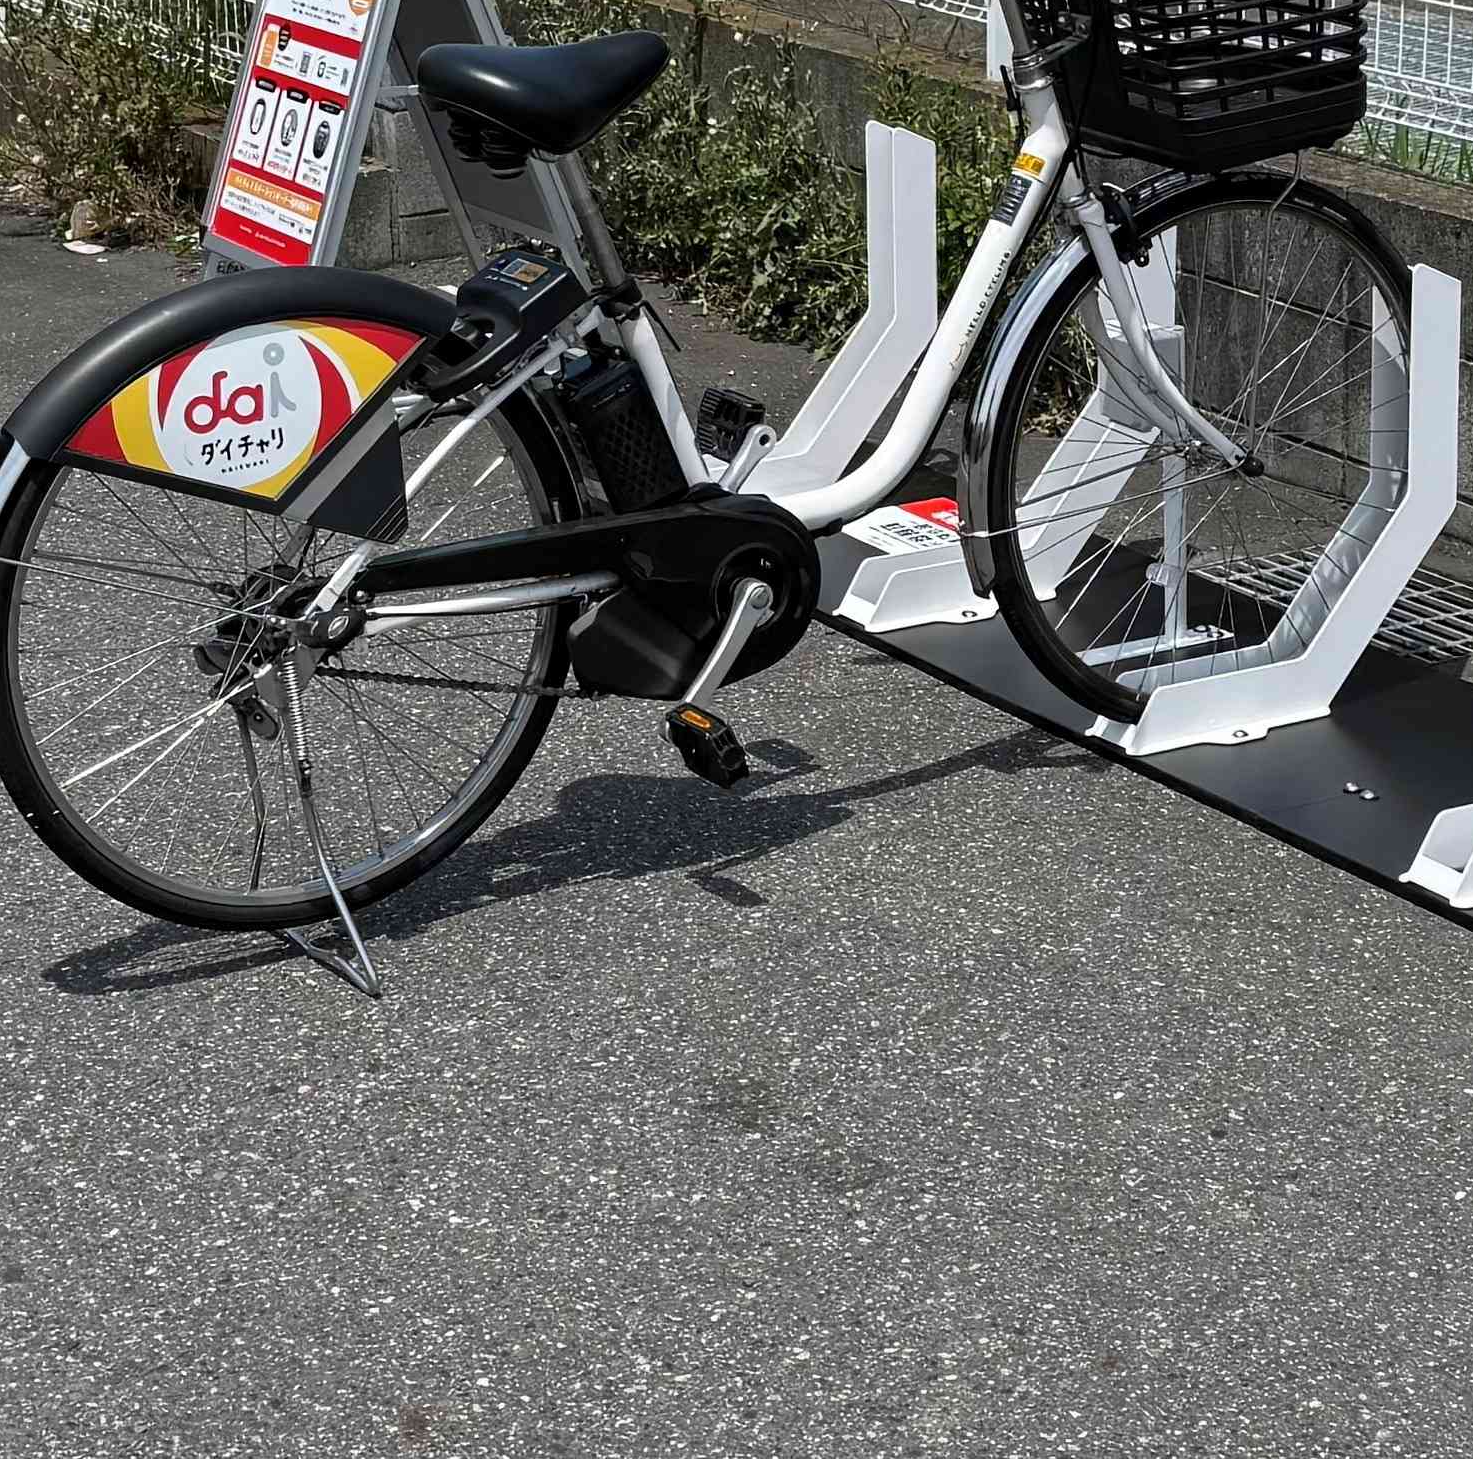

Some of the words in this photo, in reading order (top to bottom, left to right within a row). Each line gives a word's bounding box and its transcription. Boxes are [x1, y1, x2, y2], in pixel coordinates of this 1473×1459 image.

[183, 342, 297, 435] dai
[200, 427, 285, 466] ダイチャリ
